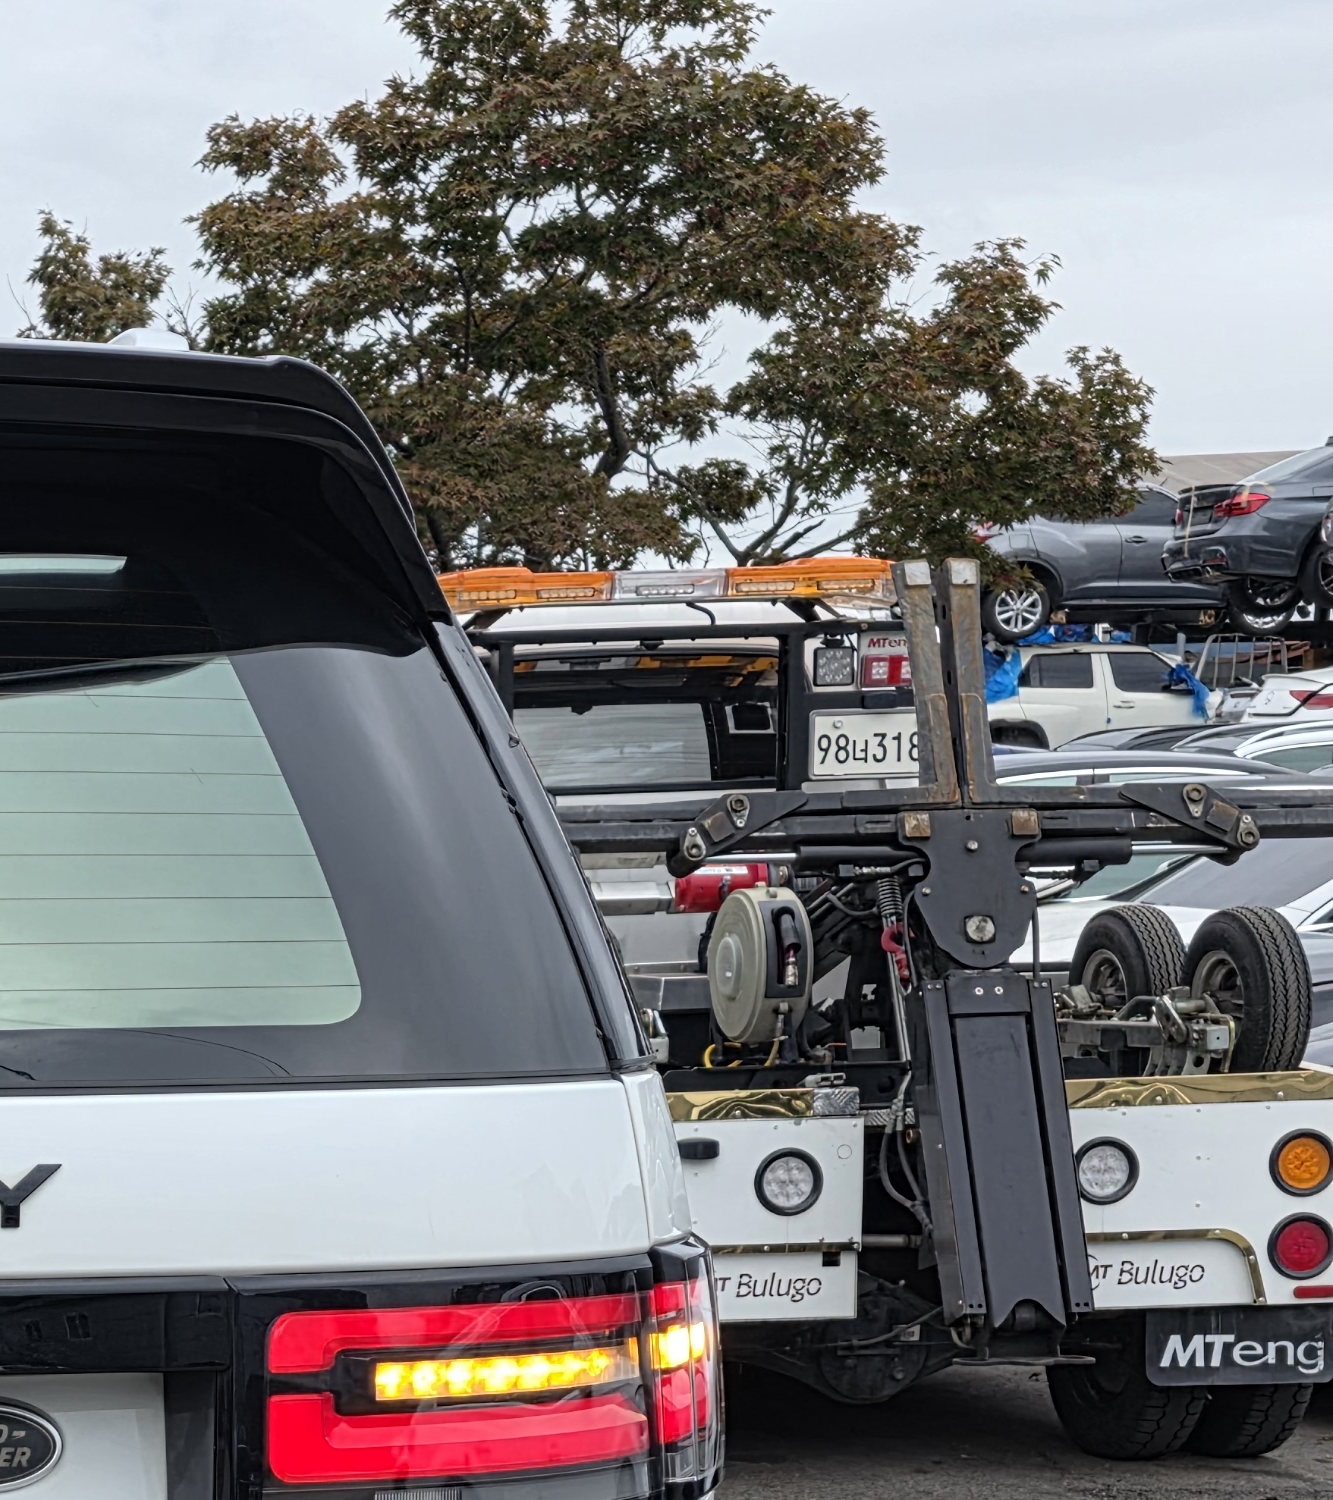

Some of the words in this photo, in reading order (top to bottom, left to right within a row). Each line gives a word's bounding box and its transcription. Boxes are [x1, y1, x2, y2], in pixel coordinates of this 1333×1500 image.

[715, 1276, 731, 1292] T
[736, 1272, 822, 1303] Bulugo
[1117, 1259, 1206, 1290] Bulugo
[1159, 1334, 1325, 1374] MTeng
